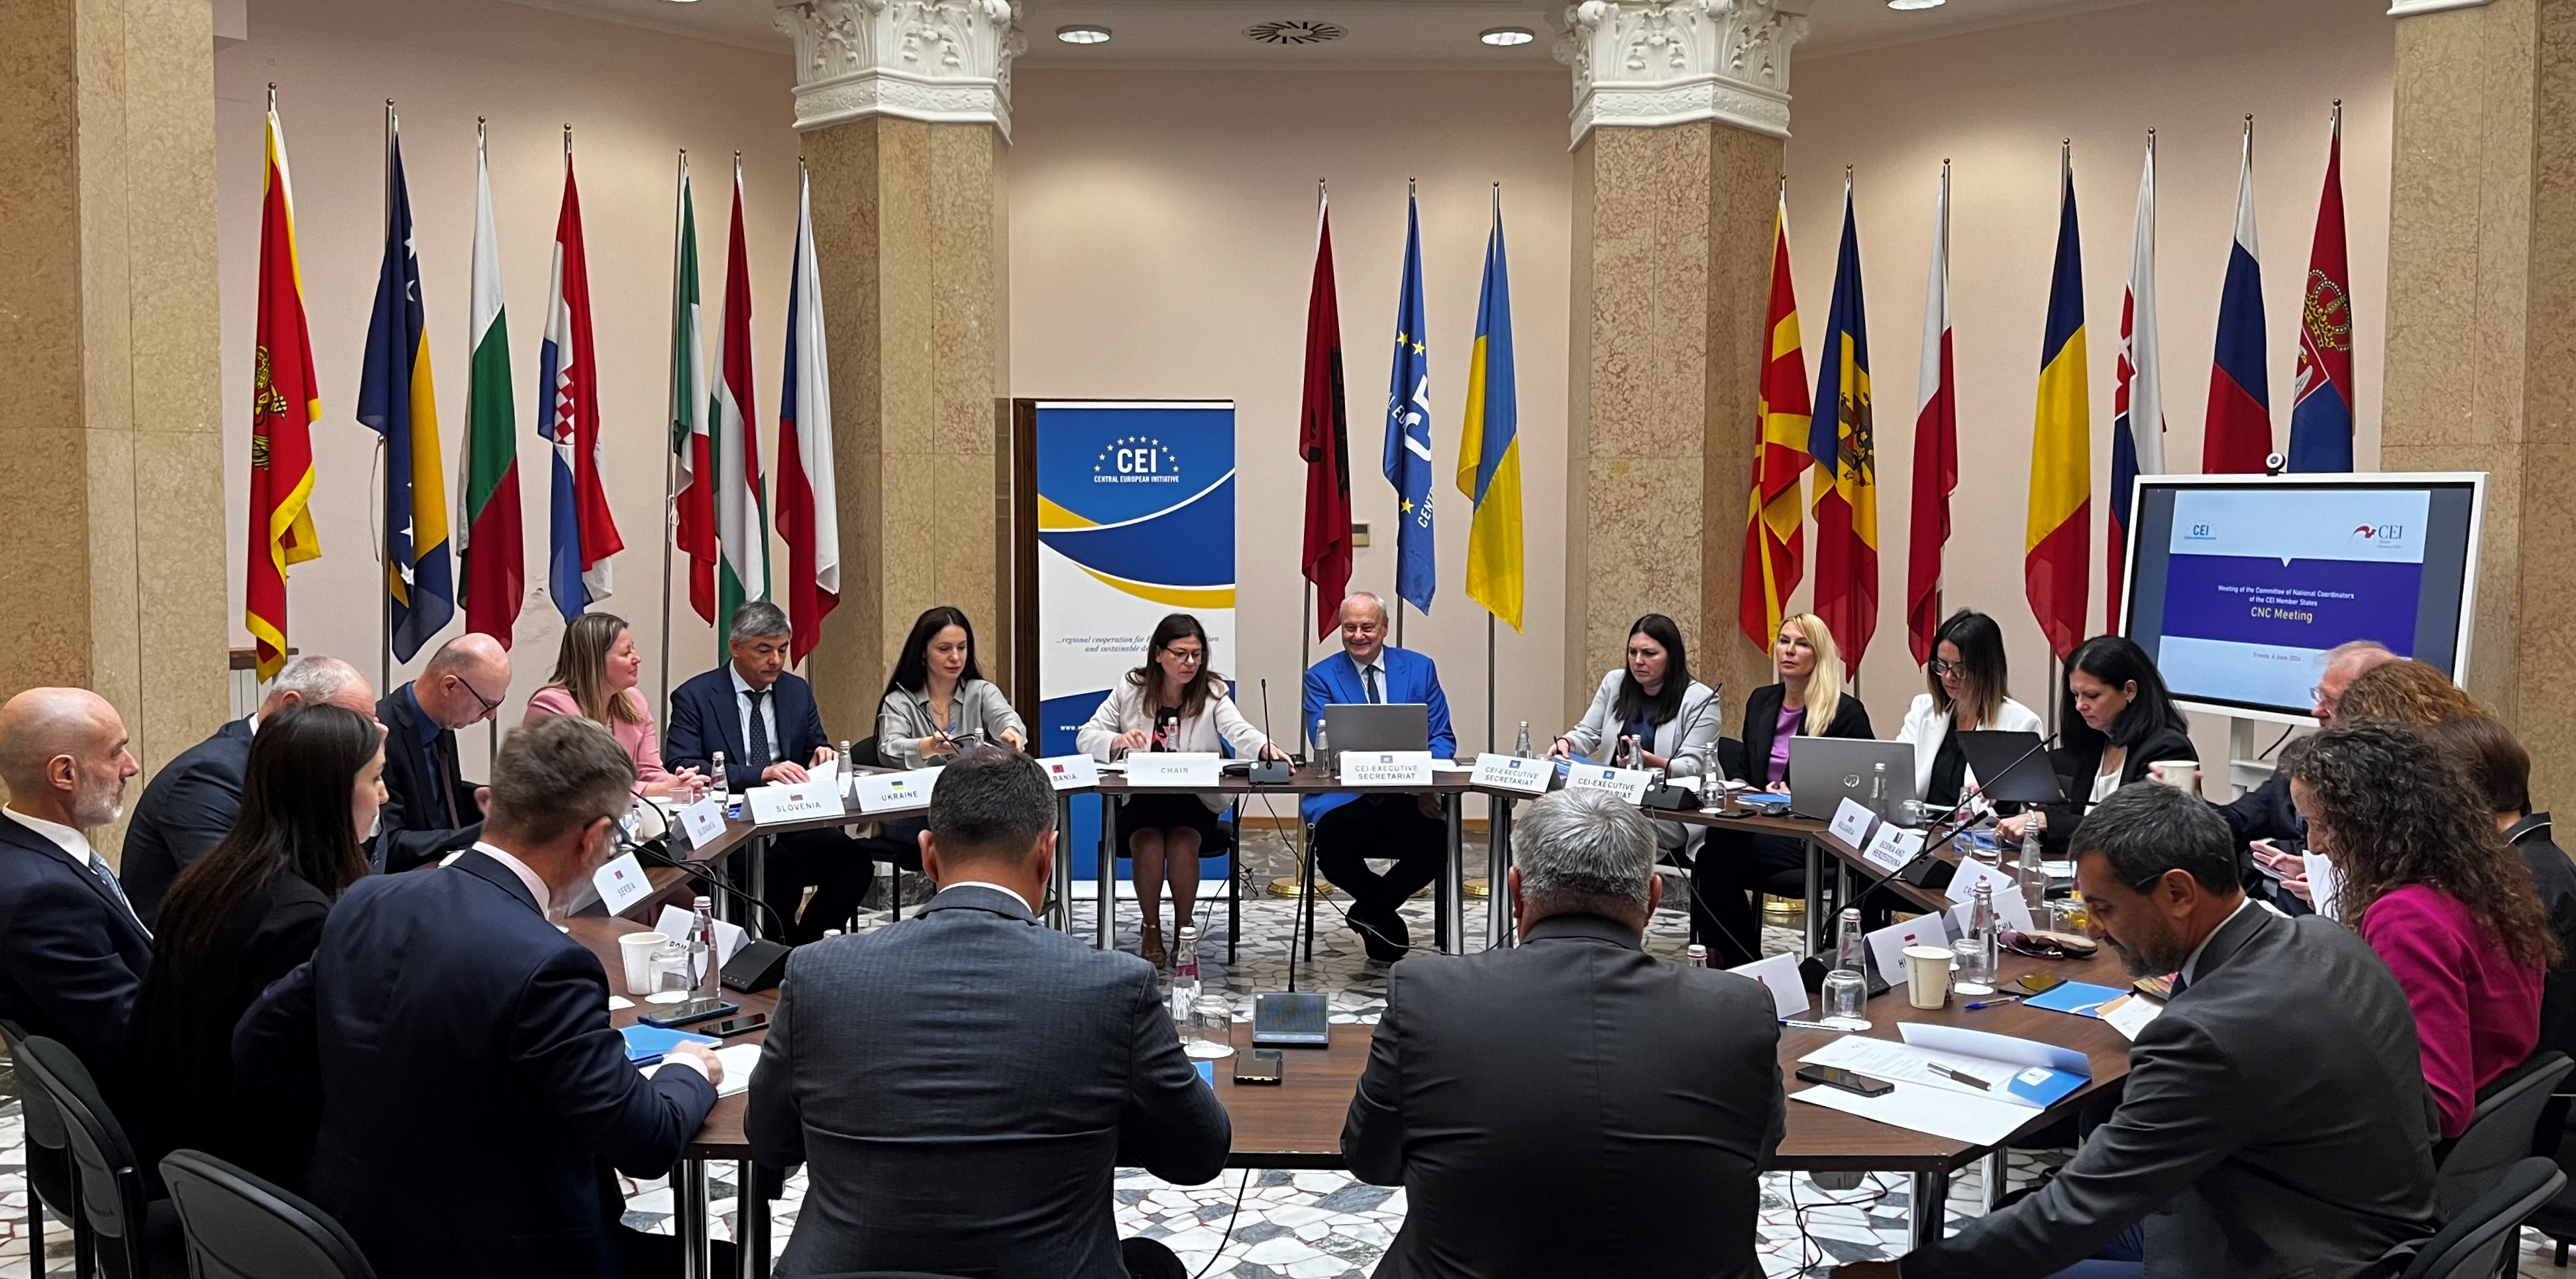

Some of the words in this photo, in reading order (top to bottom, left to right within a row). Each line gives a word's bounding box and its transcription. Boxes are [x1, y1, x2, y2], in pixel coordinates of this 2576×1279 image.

[1117, 449, 1157, 473] CEI
[2193, 525, 2209, 535] CEI
[2378, 525, 2402, 539] CEI
[2317, 590, 2354, 599] Coordinators
[2299, 598, 2317, 607] States
[2251, 607, 2272, 618] CNC
[2275, 608, 2312, 624] Meeting
[1132, 636, 1146, 645] for
[1485, 767, 1539, 779] CEI-EXECUTIVE
[1485, 774, 1534, 786] SECRETARIAT
[1578, 778, 1635, 791] CEI-EXECUTIVE
[881, 791, 918, 801] UKRAINE
[776, 802, 822, 812] SLOVENIA
[1879, 840, 1896, 853] BOSNIA
[1895, 848, 1905, 858] AND
[1872, 849, 1902, 867] HERZEGOVINA
[617, 882, 637, 897] SERBIA
